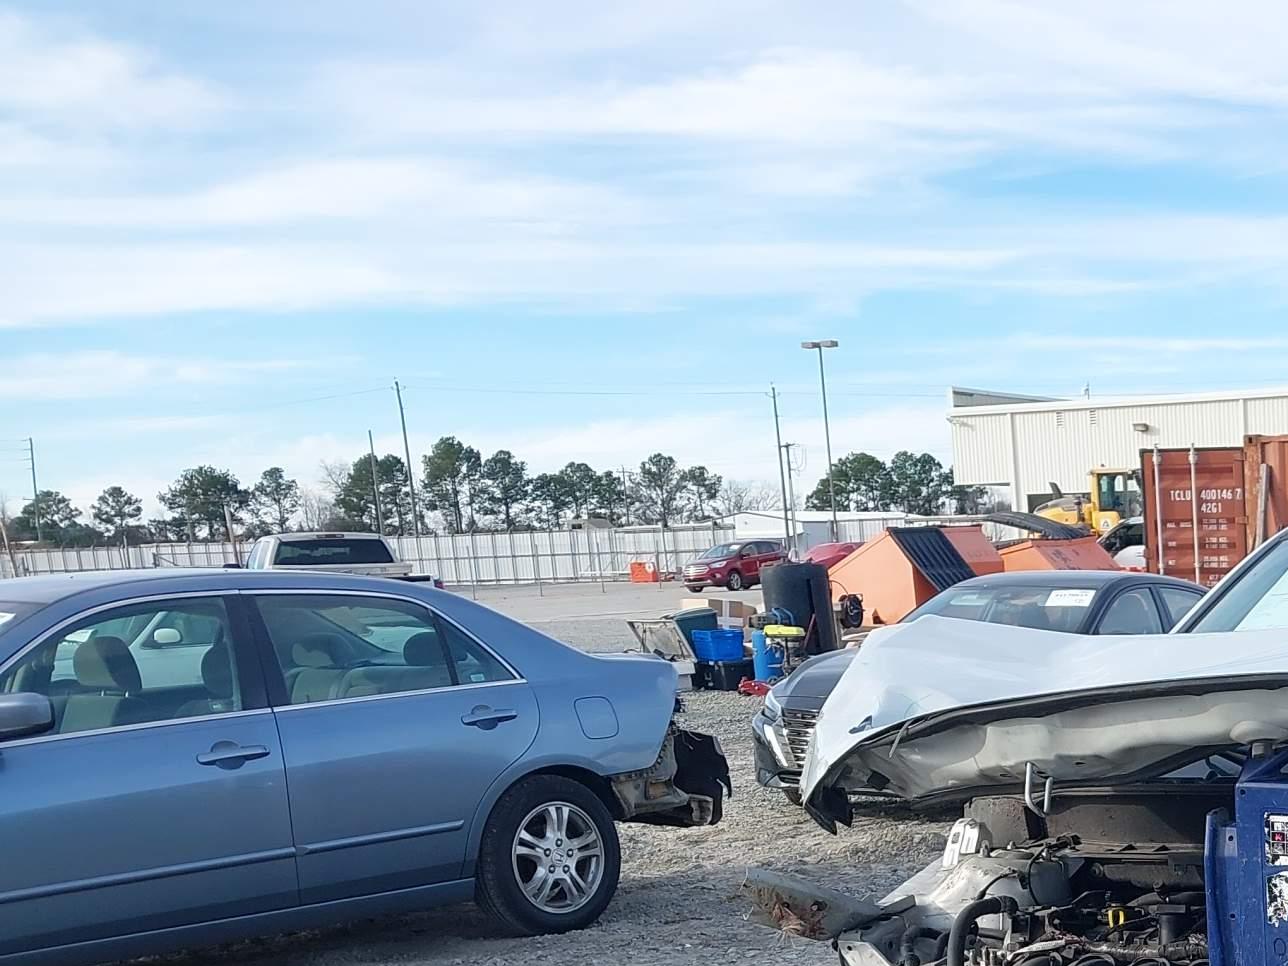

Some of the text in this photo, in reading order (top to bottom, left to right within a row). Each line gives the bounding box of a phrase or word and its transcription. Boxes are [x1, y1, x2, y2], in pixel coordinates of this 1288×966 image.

[1170, 487, 1242, 501] TCLU 400146 7
[1201, 502, 1222, 513] 42G1
